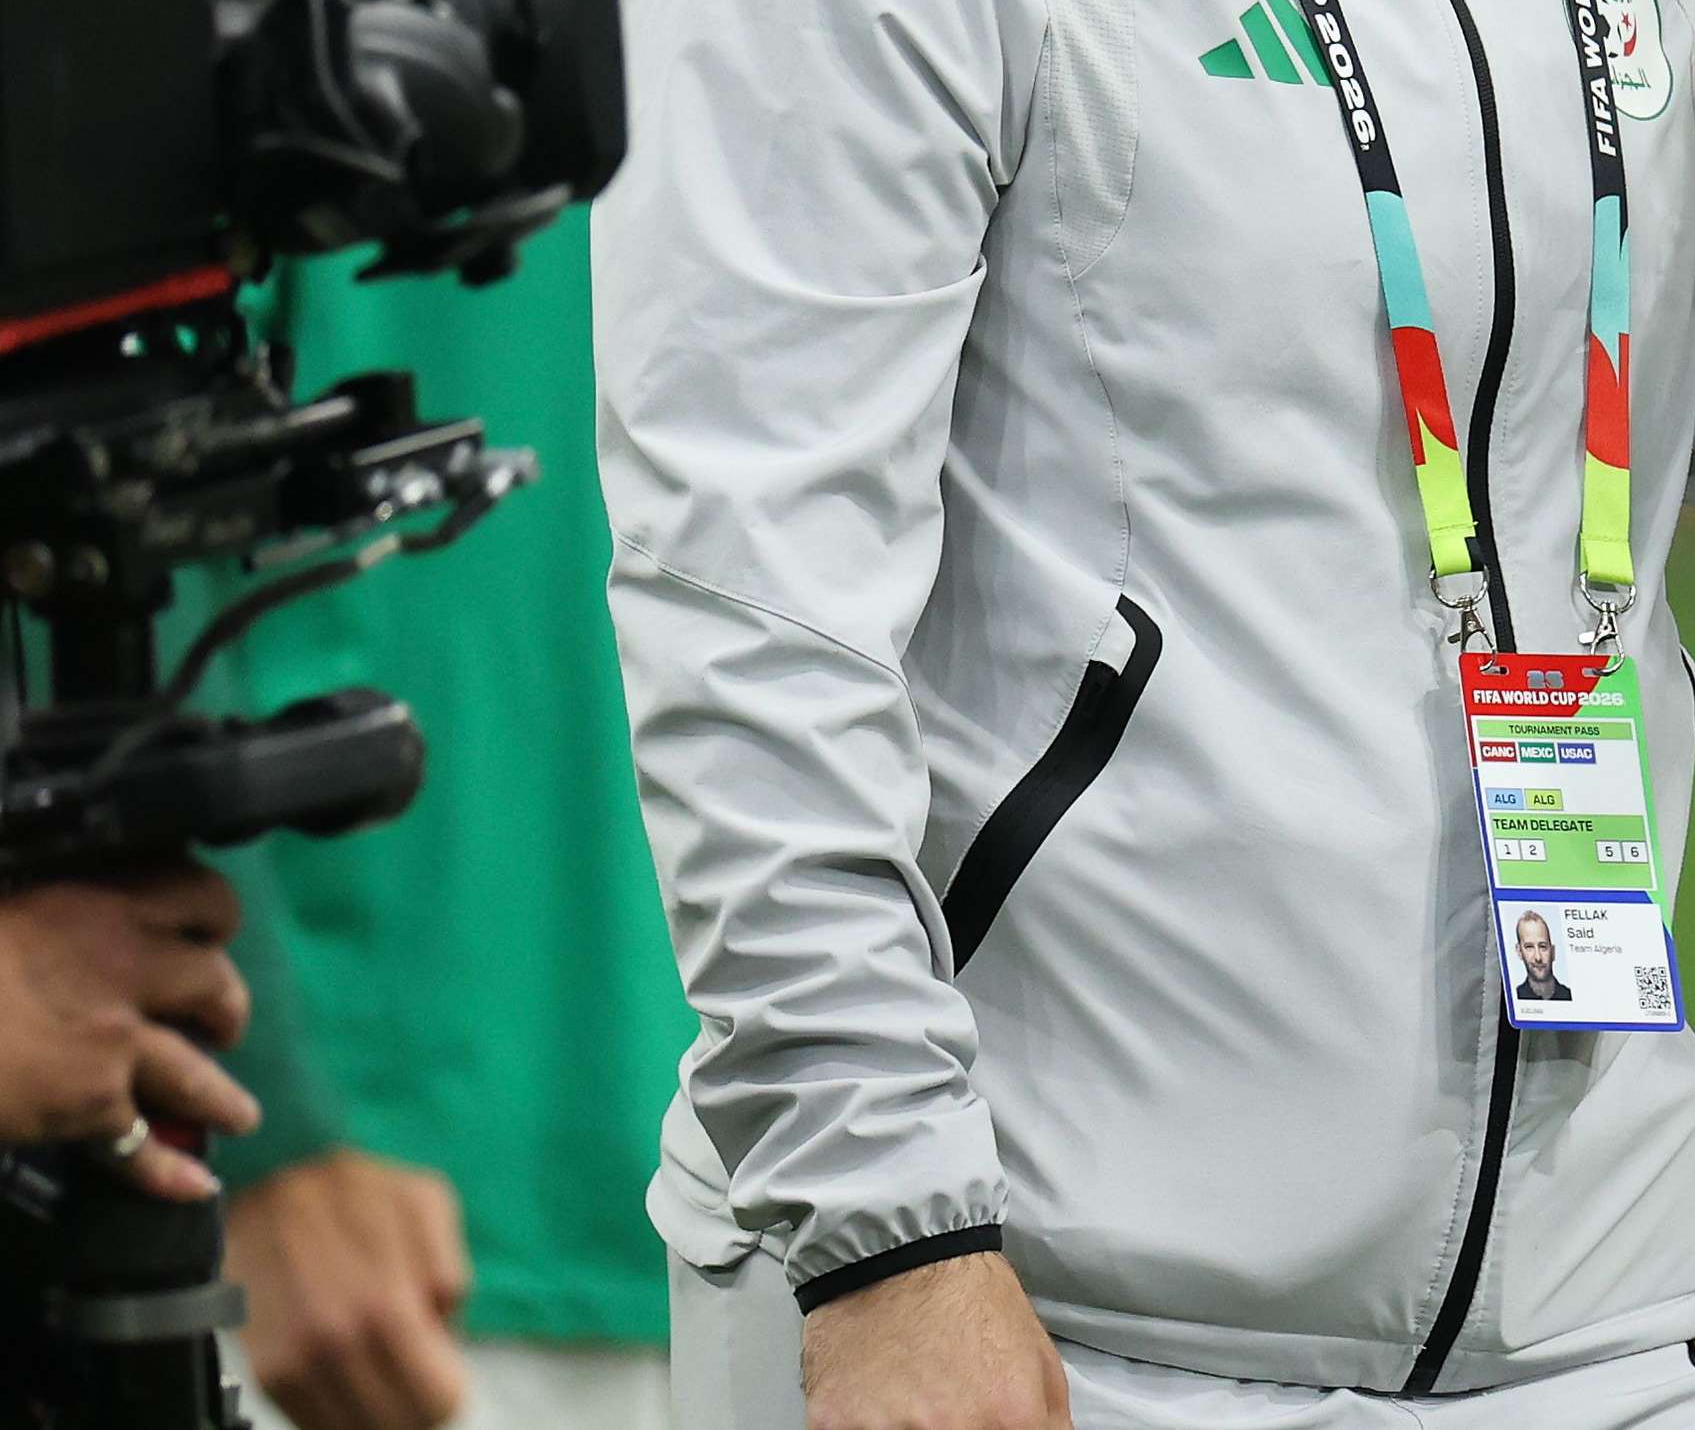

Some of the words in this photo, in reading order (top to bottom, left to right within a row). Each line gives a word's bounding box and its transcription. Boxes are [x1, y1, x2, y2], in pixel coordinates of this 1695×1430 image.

[1314, 12, 1376, 145] 2026
[1590, 77, 1617, 158] FIFA
[1473, 690, 1502, 704] FIFA
[1502, 690, 1549, 705] WORLD
[1550, 691, 1578, 706] CUP
[1578, 692, 1624, 706] 2026
[1509, 725, 1571, 735] TOURNAMENT
[1575, 726, 1600, 736] PASS
[1482, 747, 1515, 758] CANC
[1521, 748, 1553, 759] MEXC
[1560, 748, 1592, 759] USAC
[1494, 794, 1516, 804] ALG
[1533, 795, 1555, 805] ALG
[1493, 818, 1528, 830] TEAM
[1531, 820, 1594, 832] DELEGATE
[1504, 844, 1511, 855] 1
[1529, 844, 1537, 856] 2
[1605, 846, 1613, 857] 5
[1630, 846, 1639, 857] 6
[1564, 909, 1608, 921] FELLAK
[1570, 944, 1592, 953] Team
